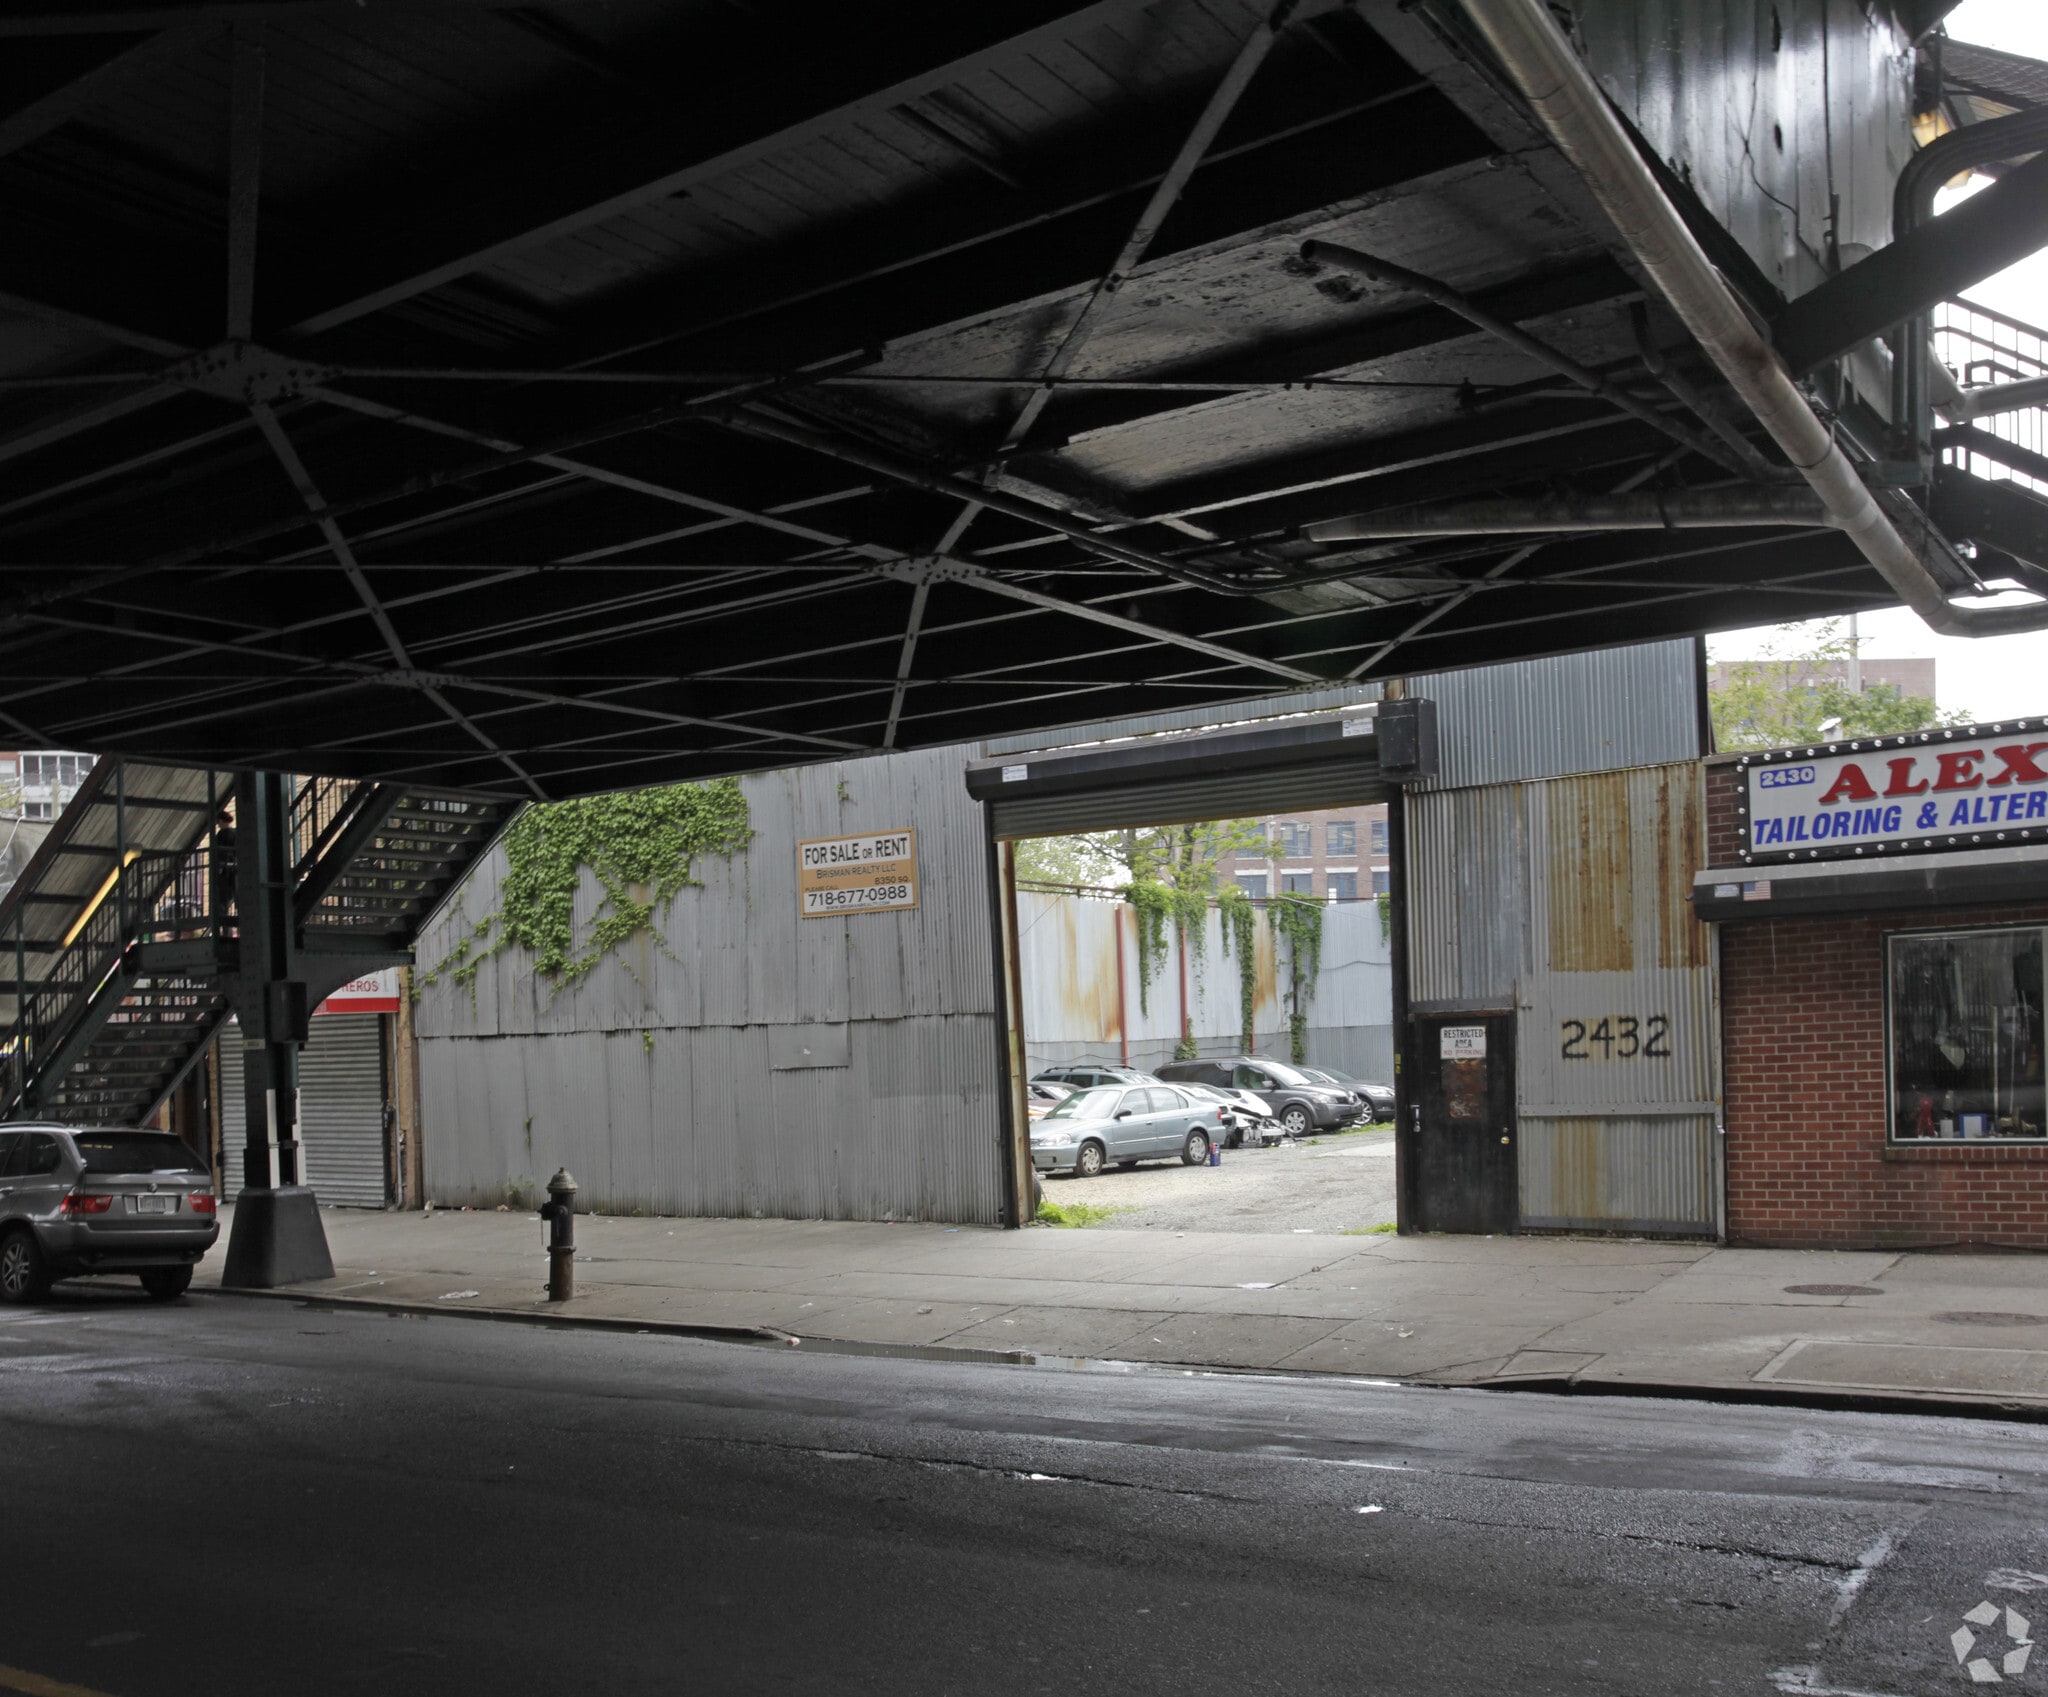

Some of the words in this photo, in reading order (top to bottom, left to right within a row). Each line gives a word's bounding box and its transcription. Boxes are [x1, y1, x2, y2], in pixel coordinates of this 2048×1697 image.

[1762, 769, 1813, 787] 2430
[1818, 742, 2048, 804] ALEX
[1753, 805, 1901, 845] TAILORING
[1916, 801, 1938, 829] &
[1949, 791, 2048, 826] ALTER
[805, 846, 827, 865] FOR
[830, 843, 859, 863] SALE
[876, 837, 907, 857] RENT
[852, 865, 881, 875] REALTY
[882, 863, 896, 873] LLC
[874, 875, 896, 885] 8350
[808, 885, 907, 907] 718-677-0988
[1443, 1028, 1483, 1038] RESTRICTED
[1562, 1014, 1671, 1060] 2432
